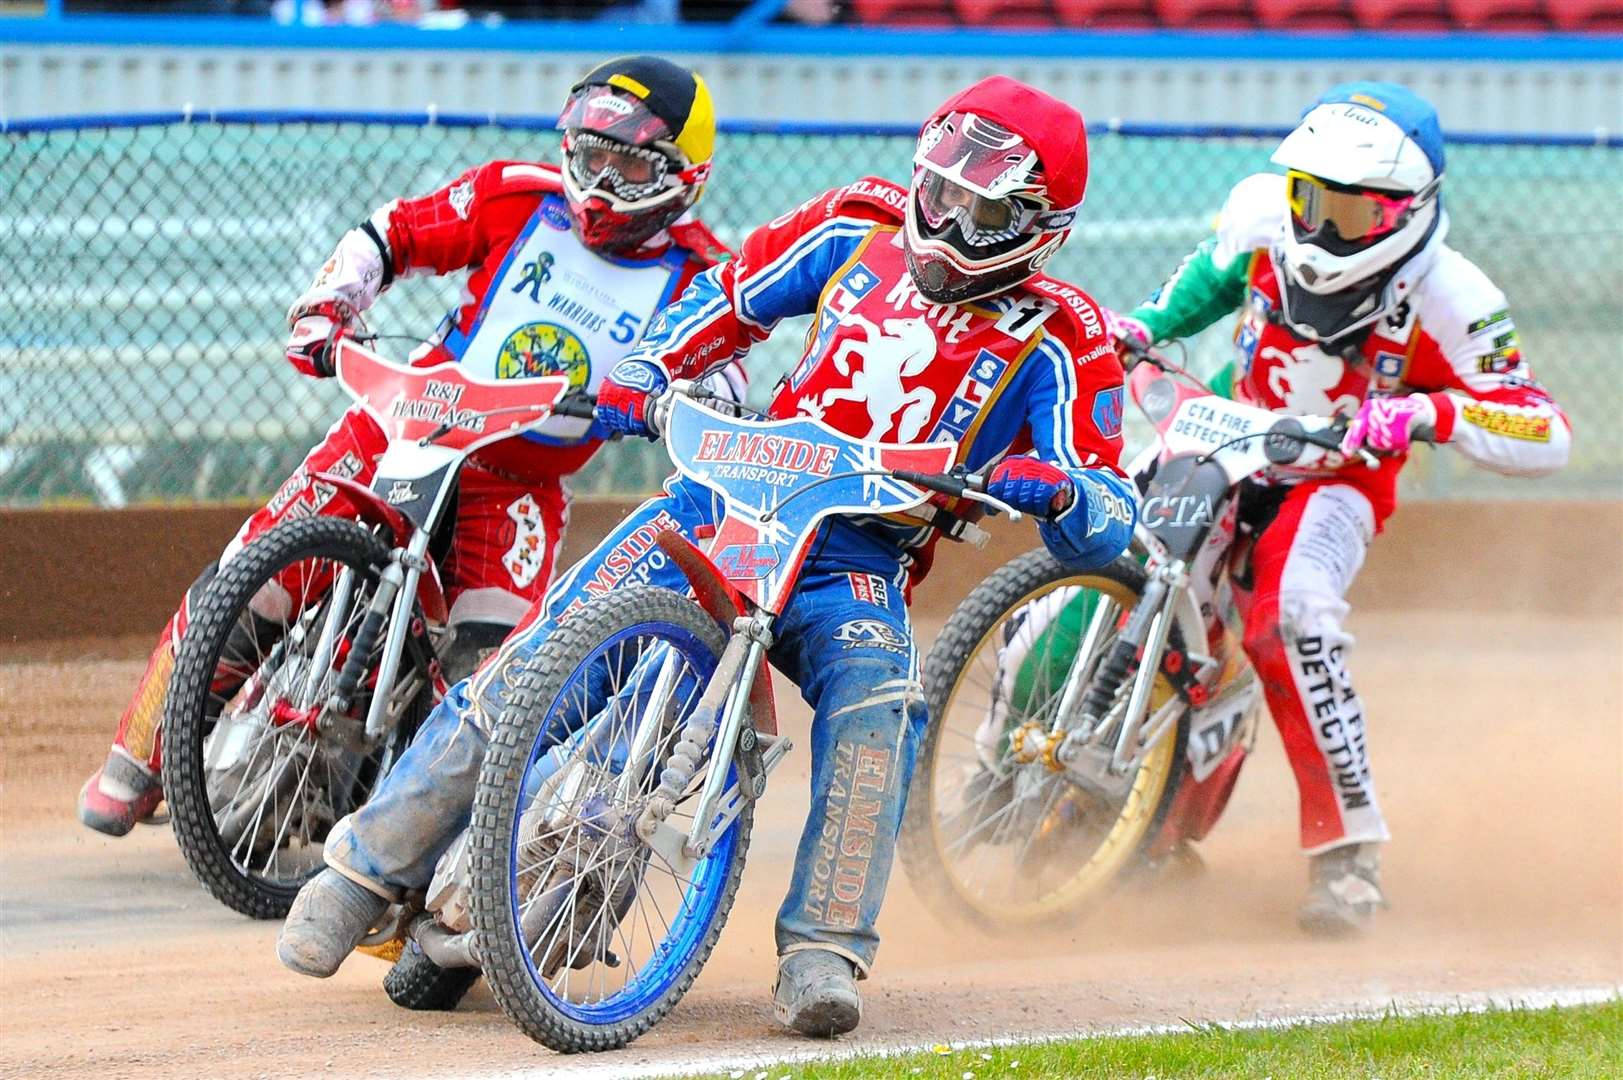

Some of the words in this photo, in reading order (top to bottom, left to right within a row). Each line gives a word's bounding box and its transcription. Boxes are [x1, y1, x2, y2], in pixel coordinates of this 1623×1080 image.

[548, 292, 607, 334] WARRIORS
[1007, 307, 1043, 333] 1
[1033, 279, 1103, 340] ELMSIDE
[1387, 301, 1411, 330] 3
[609, 311, 642, 345] 5
[426, 379, 465, 403] R&J
[393, 400, 486, 433] HAULAGE
[1188, 403, 1216, 424] CTA
[1222, 413, 1252, 433] FIRE
[693, 430, 839, 477] ELMSIDE
[1174, 419, 1251, 455] DETECTION
[713, 464, 800, 488] TRANSPORT
[1141, 494, 1216, 529] CTA
[1296, 635, 1371, 812] DETECTION
[803, 743, 856, 925] TRANSPORT
[825, 744, 890, 930] ELMSIDE
